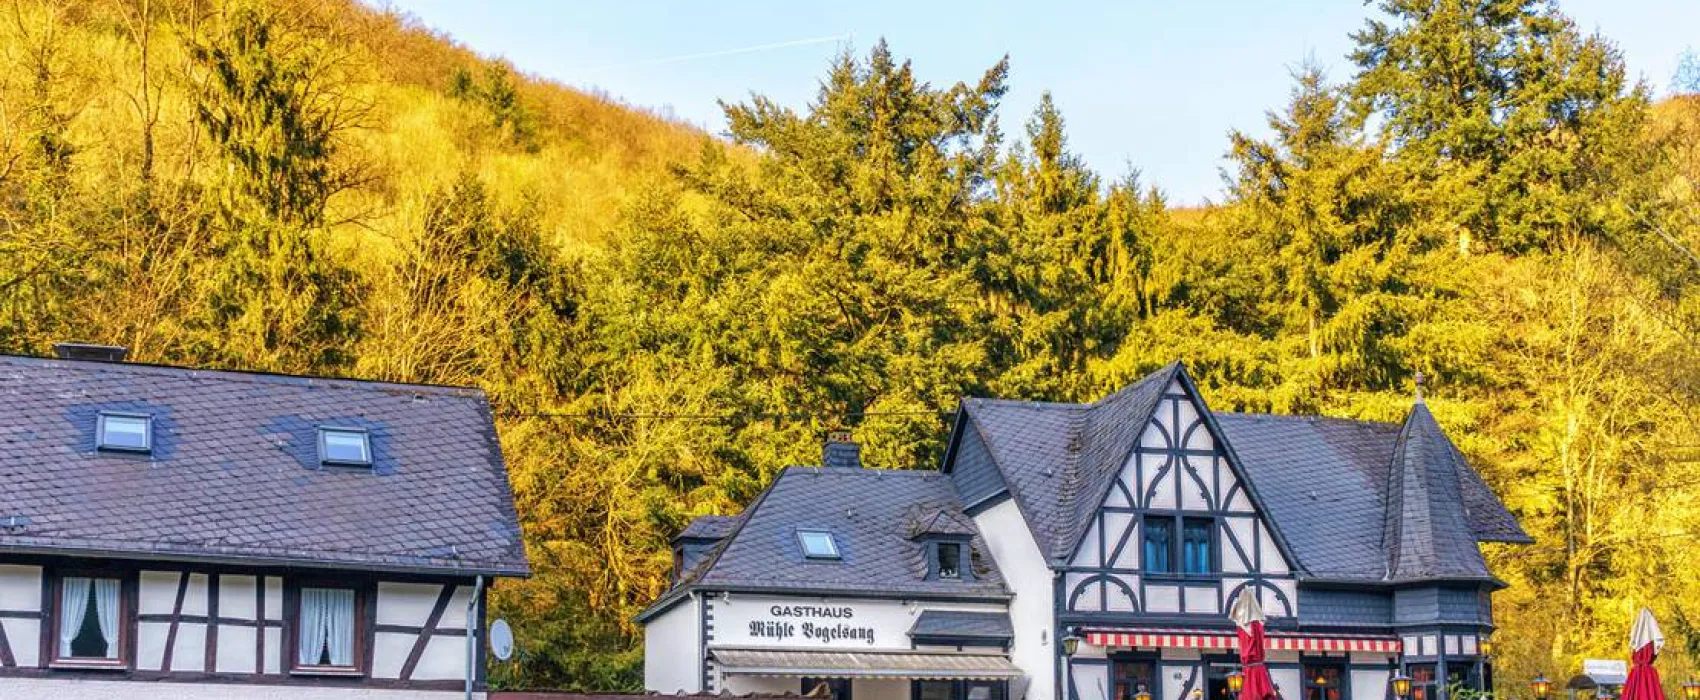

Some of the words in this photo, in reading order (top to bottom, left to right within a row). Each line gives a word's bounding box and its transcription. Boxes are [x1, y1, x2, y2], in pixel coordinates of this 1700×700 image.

[770, 605, 853, 618] GASTHAUS
[749, 621, 794, 640] Mühle
[802, 622, 875, 644] Vogelsang
